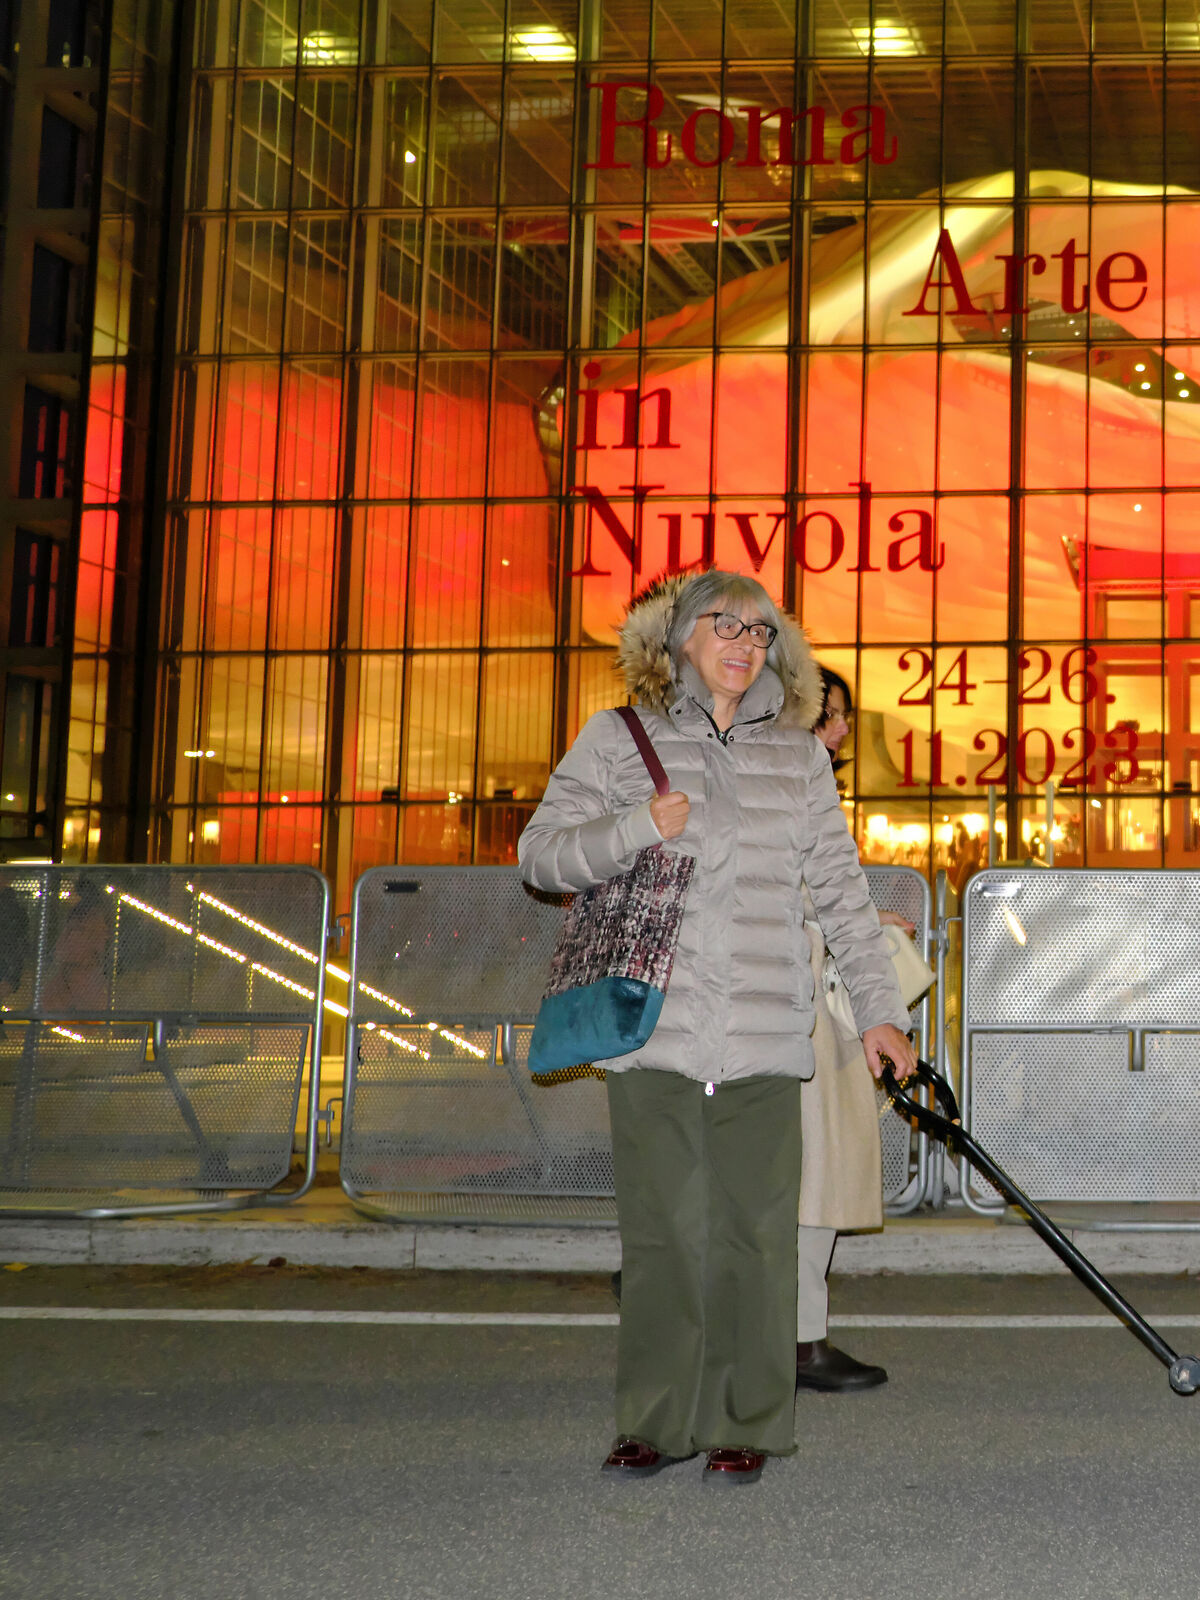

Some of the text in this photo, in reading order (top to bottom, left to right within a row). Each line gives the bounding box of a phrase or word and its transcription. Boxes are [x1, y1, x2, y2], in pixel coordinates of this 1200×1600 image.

[583, 82, 898, 170] Roma
[903, 228, 1148, 316] Arte
[574, 362, 681, 450] in
[567, 482, 945, 577] Nuvola
[896, 727, 1140, 787] 11.2023
